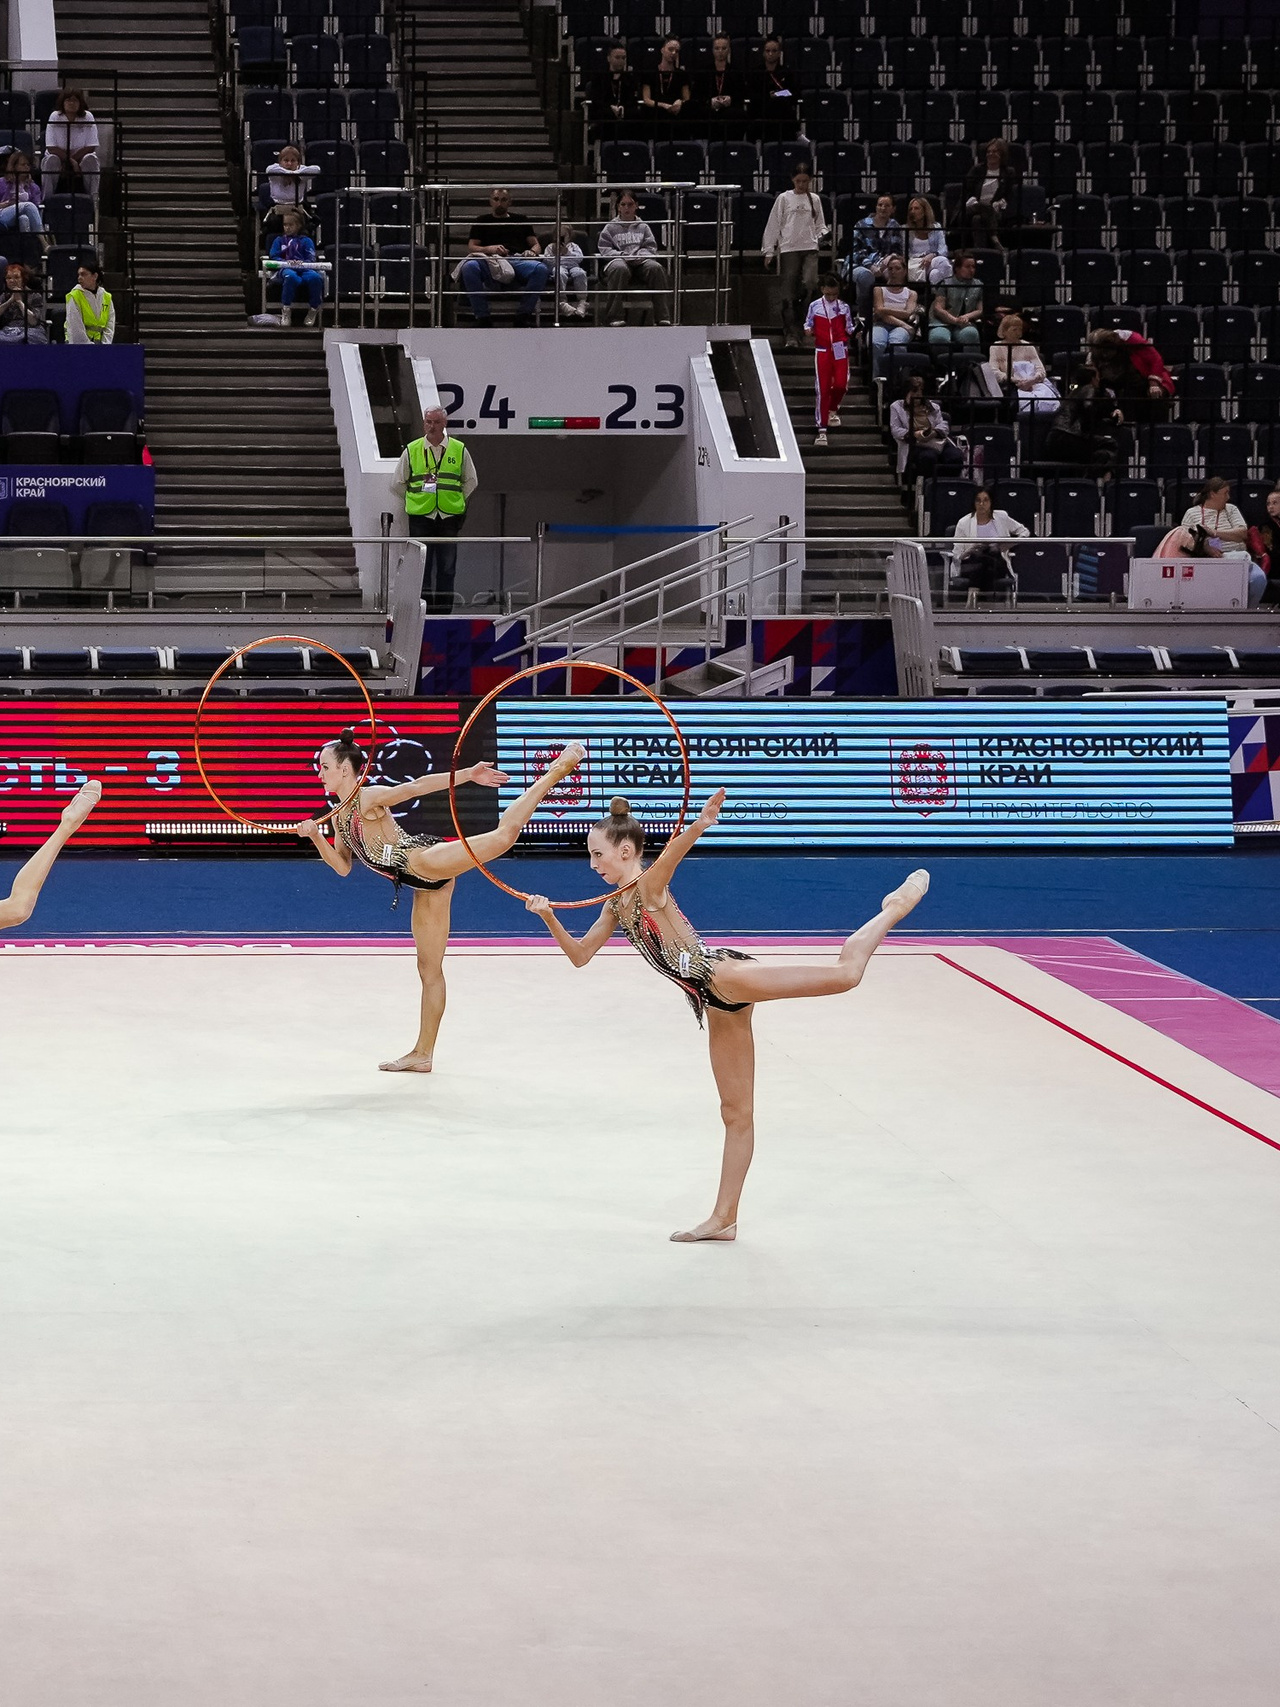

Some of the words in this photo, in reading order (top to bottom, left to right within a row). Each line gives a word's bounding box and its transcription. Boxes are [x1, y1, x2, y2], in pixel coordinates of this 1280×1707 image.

[436, 383, 516, 430] 2.4
[605, 384, 685, 429] 2.3
[16, 475, 106, 487] КРАСНОЯРСКИЙ
[16, 486, 46, 497] КРАЙ
[614, 732, 839, 757] КРАСНОЯРСКИЙ
[979, 732, 1204, 757] КРАСНОЯРСКИЙ
[146, 750, 181, 791] 3
